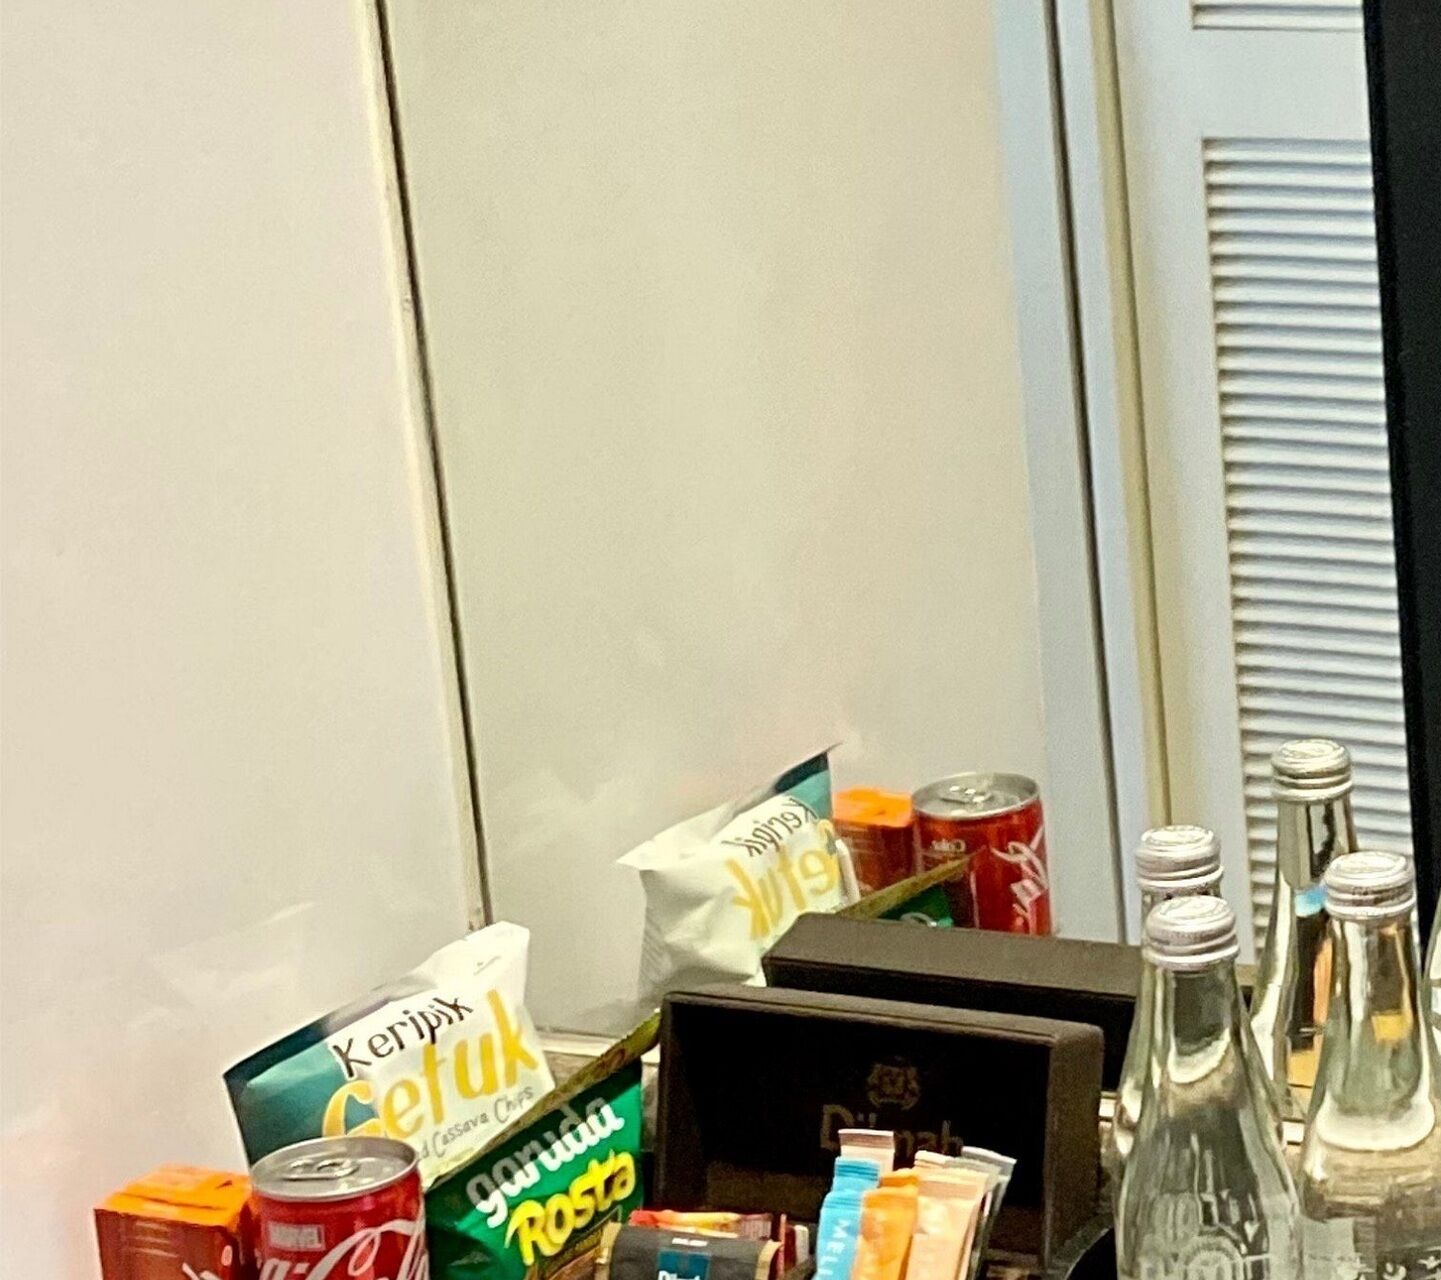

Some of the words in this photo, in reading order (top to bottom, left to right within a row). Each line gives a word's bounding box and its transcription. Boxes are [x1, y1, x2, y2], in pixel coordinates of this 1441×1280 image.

[332, 997, 474, 1078] Keripik
[432, 1112, 489, 1158] Cassava
[504, 1148, 636, 1266] Rosta
